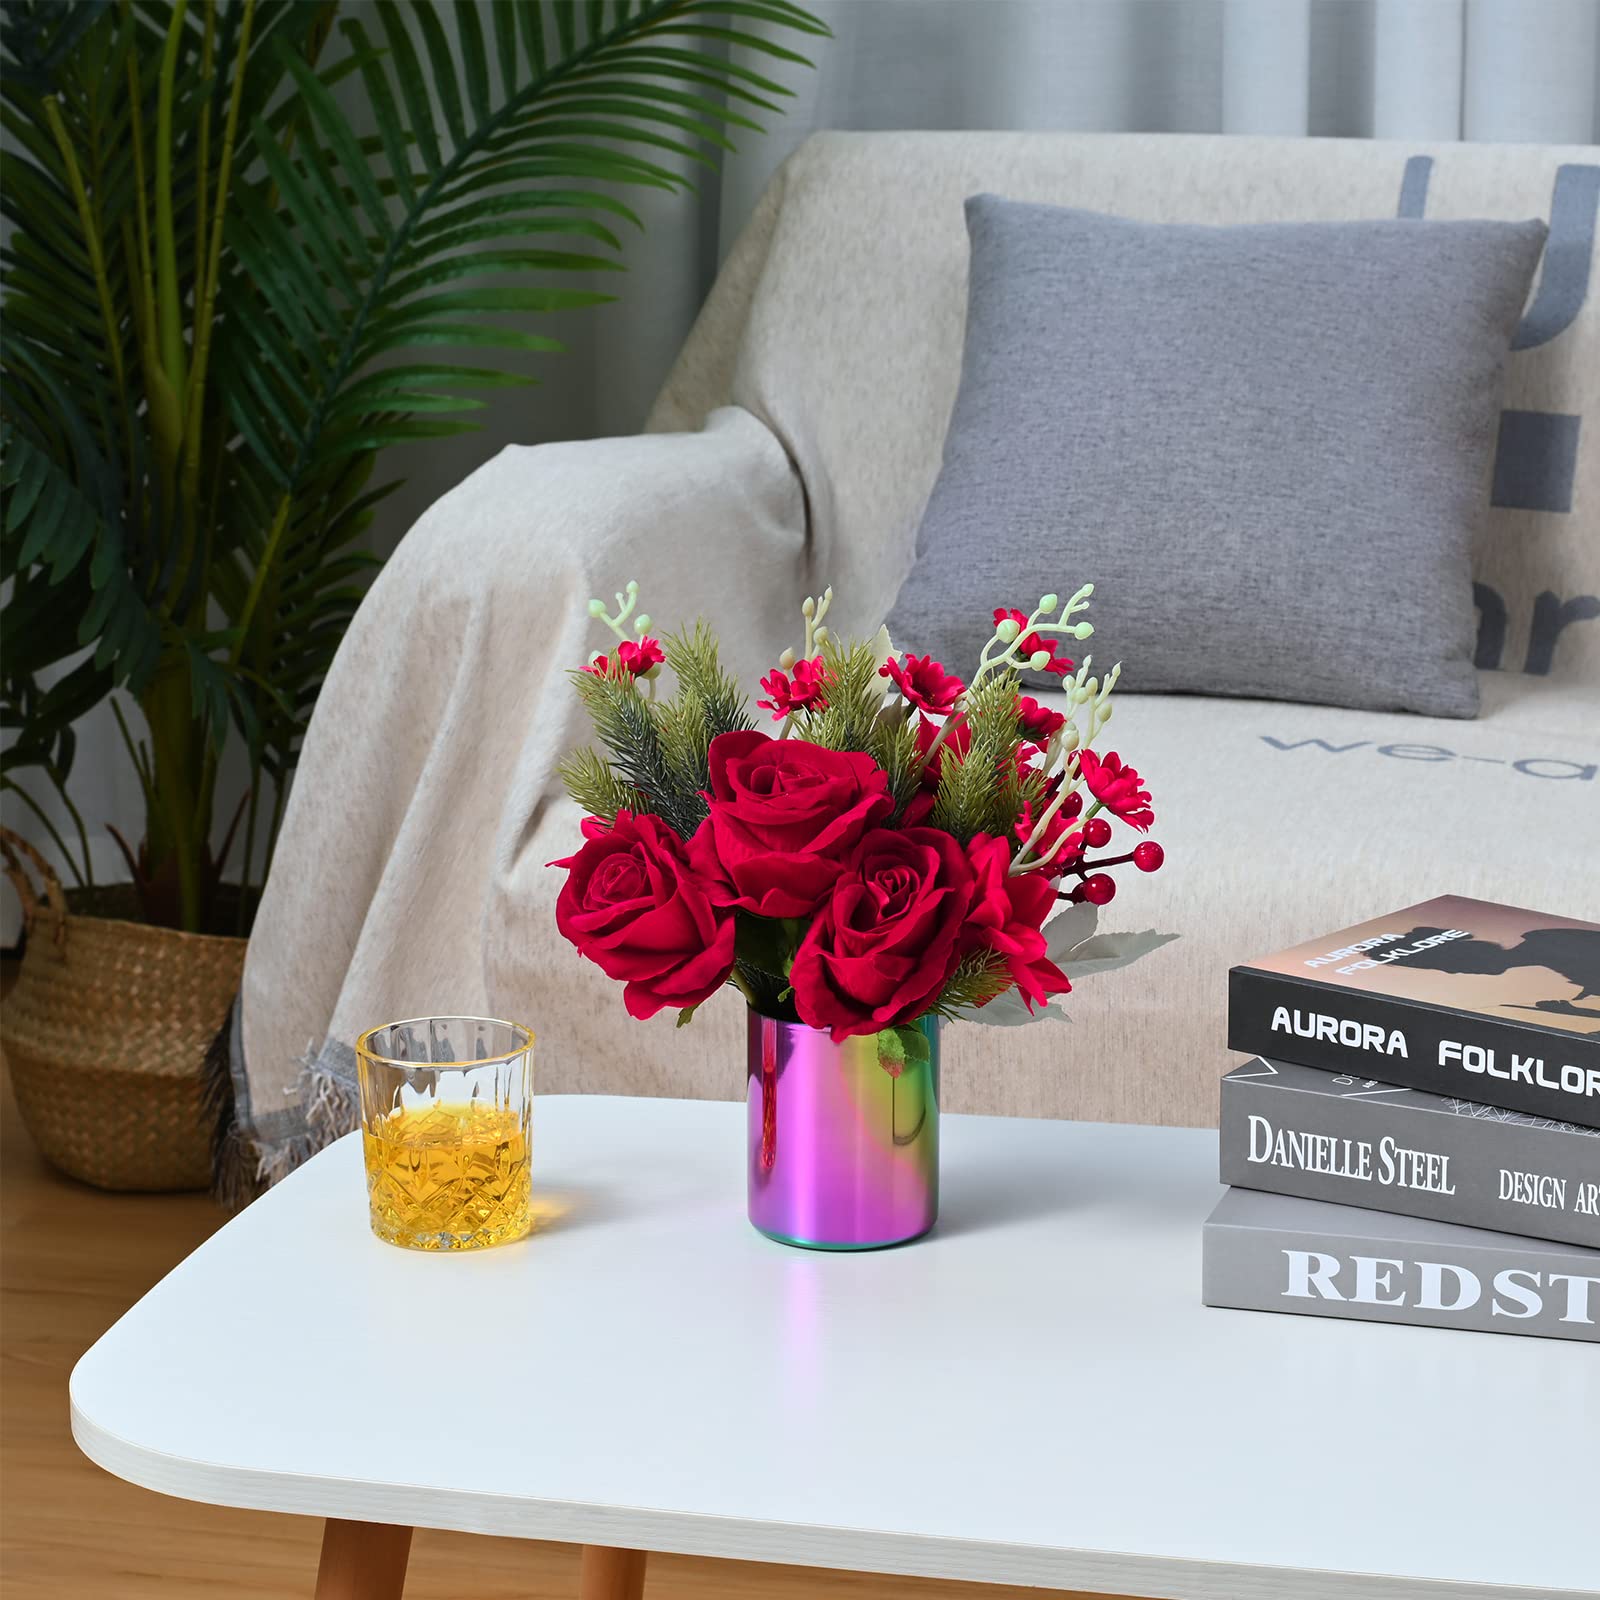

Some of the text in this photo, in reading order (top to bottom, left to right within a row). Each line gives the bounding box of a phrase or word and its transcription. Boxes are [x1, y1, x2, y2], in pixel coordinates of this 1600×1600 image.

[1304, 933, 1406, 968] AURORA
[1336, 929, 1470, 975] FOLKLORE
[1270, 1006, 1600, 1097] AURORA FOLKLOR
[1247, 1115, 1600, 1216] DANIELLE STEEL DESIGN AR
